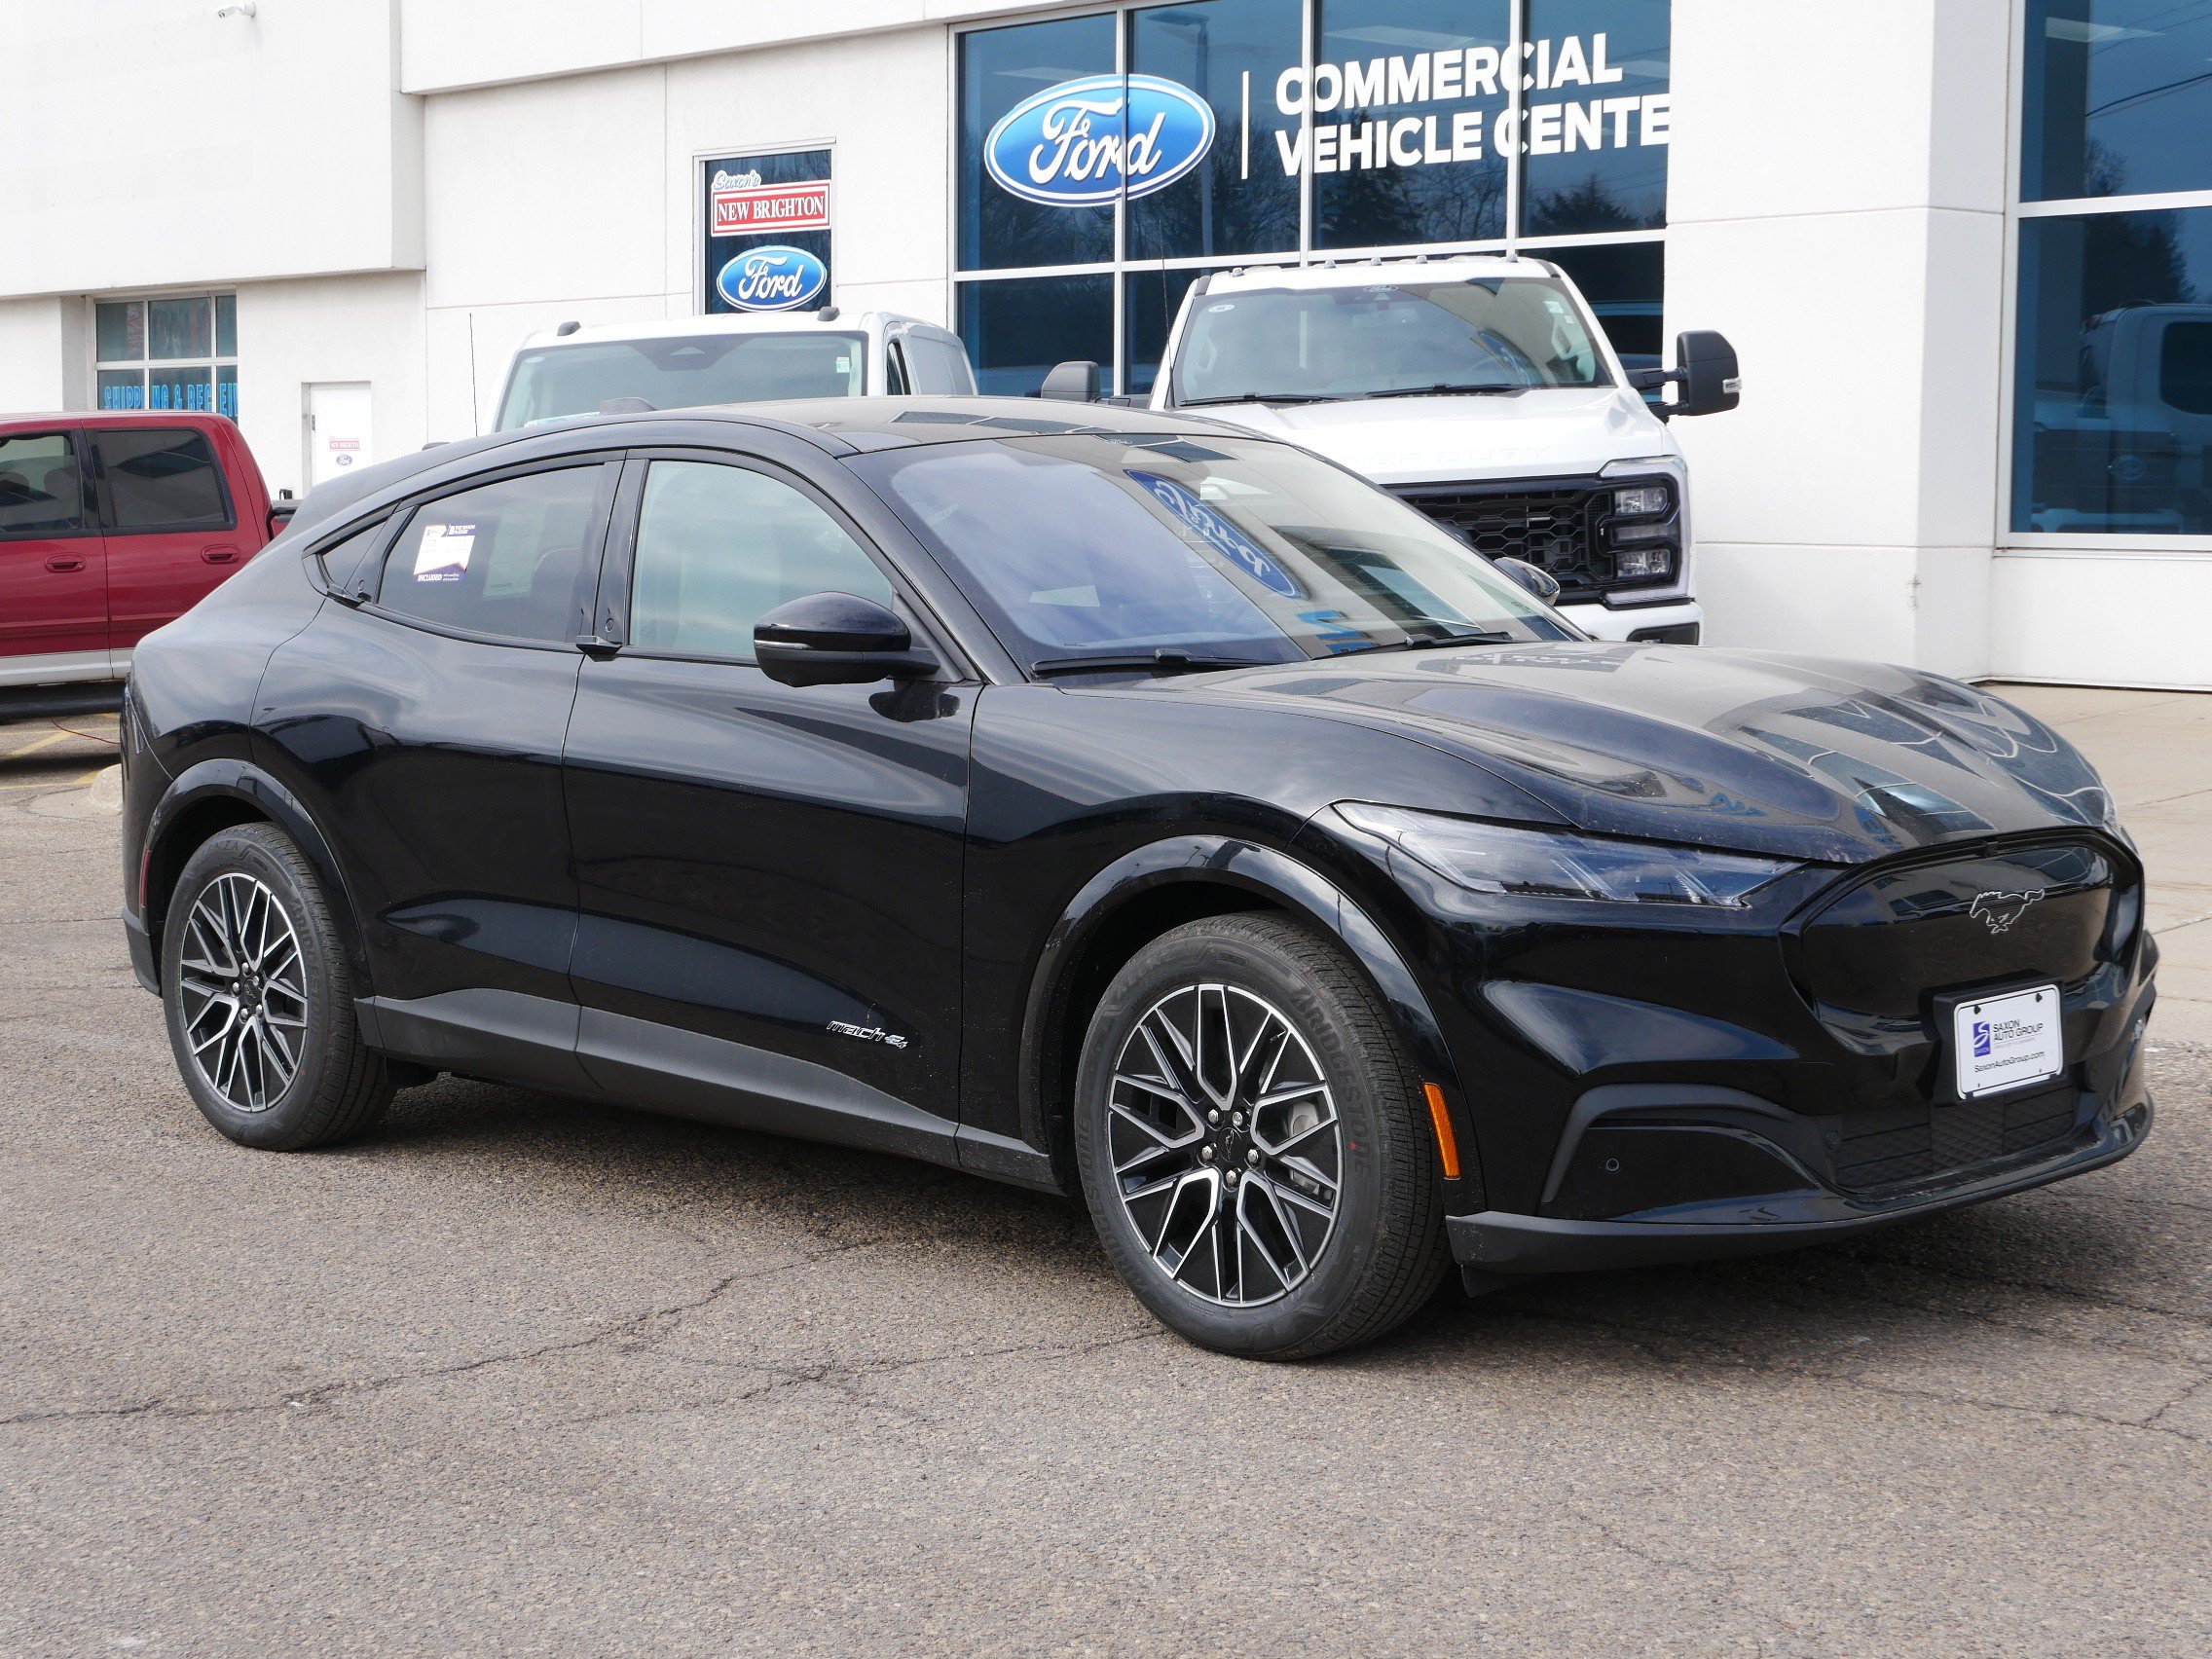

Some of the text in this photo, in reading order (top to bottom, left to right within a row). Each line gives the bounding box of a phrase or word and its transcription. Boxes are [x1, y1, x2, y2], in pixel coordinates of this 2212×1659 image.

[1275, 32, 1622, 115] COMMERCIAL
[1028, 96, 1165, 185] Ford
[1275, 107, 1483, 177] VEHICLE
[713, 170, 762, 190] Saxon's
[718, 196, 825, 222] NEW BRIGHTON
[738, 255, 804, 300] Ford
[173, 384, 183, 410] &
[1992, 1019, 2020, 1033] SAXON
[1994, 1023, 2043, 1041] AUTO GROUP
[1974, 1051, 2045, 1073] SaxonAutoGroup.com
